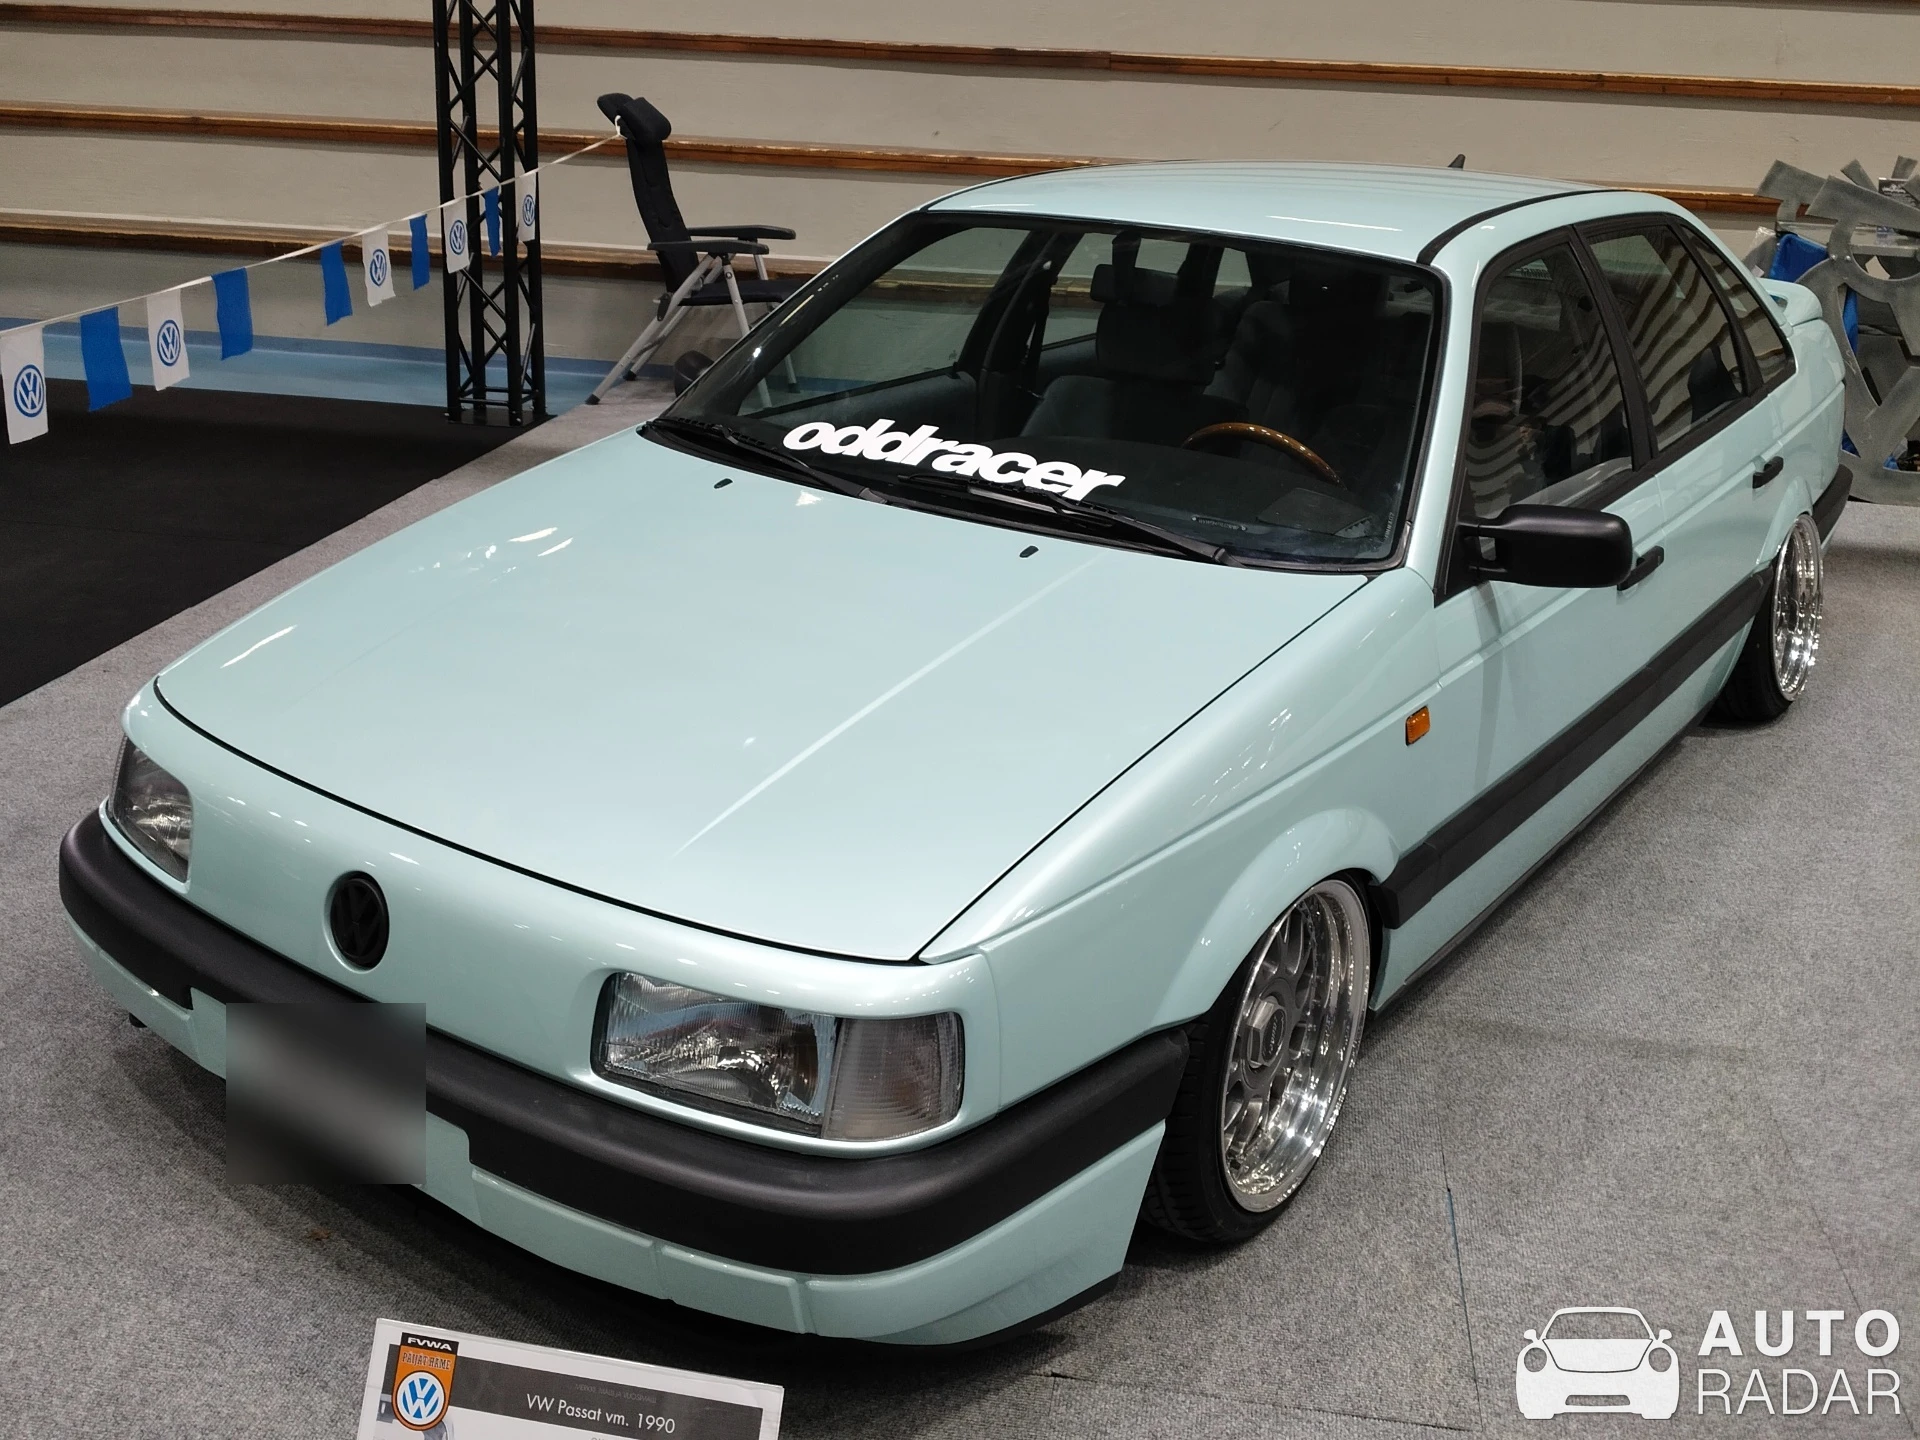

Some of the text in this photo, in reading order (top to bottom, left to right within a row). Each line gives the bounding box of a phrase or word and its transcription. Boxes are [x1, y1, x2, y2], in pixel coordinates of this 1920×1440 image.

[157, 321, 181, 365] VW
[15, 366, 44, 415] VW
[782, 418, 1126, 501] oddracer
[407, 1337, 453, 1351] FVWA
[398, 1373, 443, 1423] VW
[526, 1393, 676, 1434] VW Passat vm. 1990
